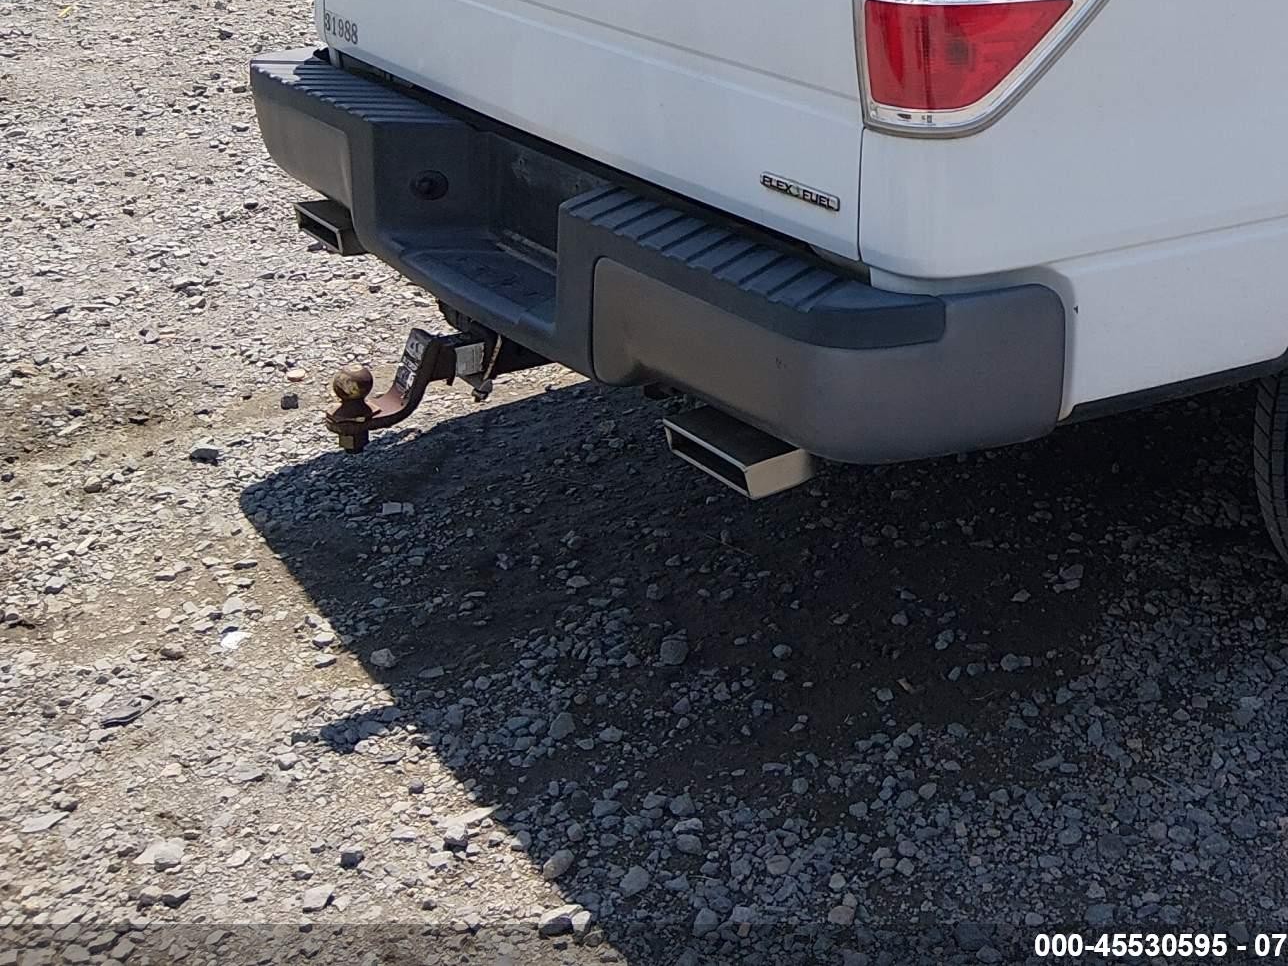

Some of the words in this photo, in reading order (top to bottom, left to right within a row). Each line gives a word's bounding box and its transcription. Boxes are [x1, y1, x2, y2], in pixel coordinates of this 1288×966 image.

[324, 12, 358, 44] 31988
[762, 174, 793, 195] FLEX
[802, 189, 837, 210] FUEL
